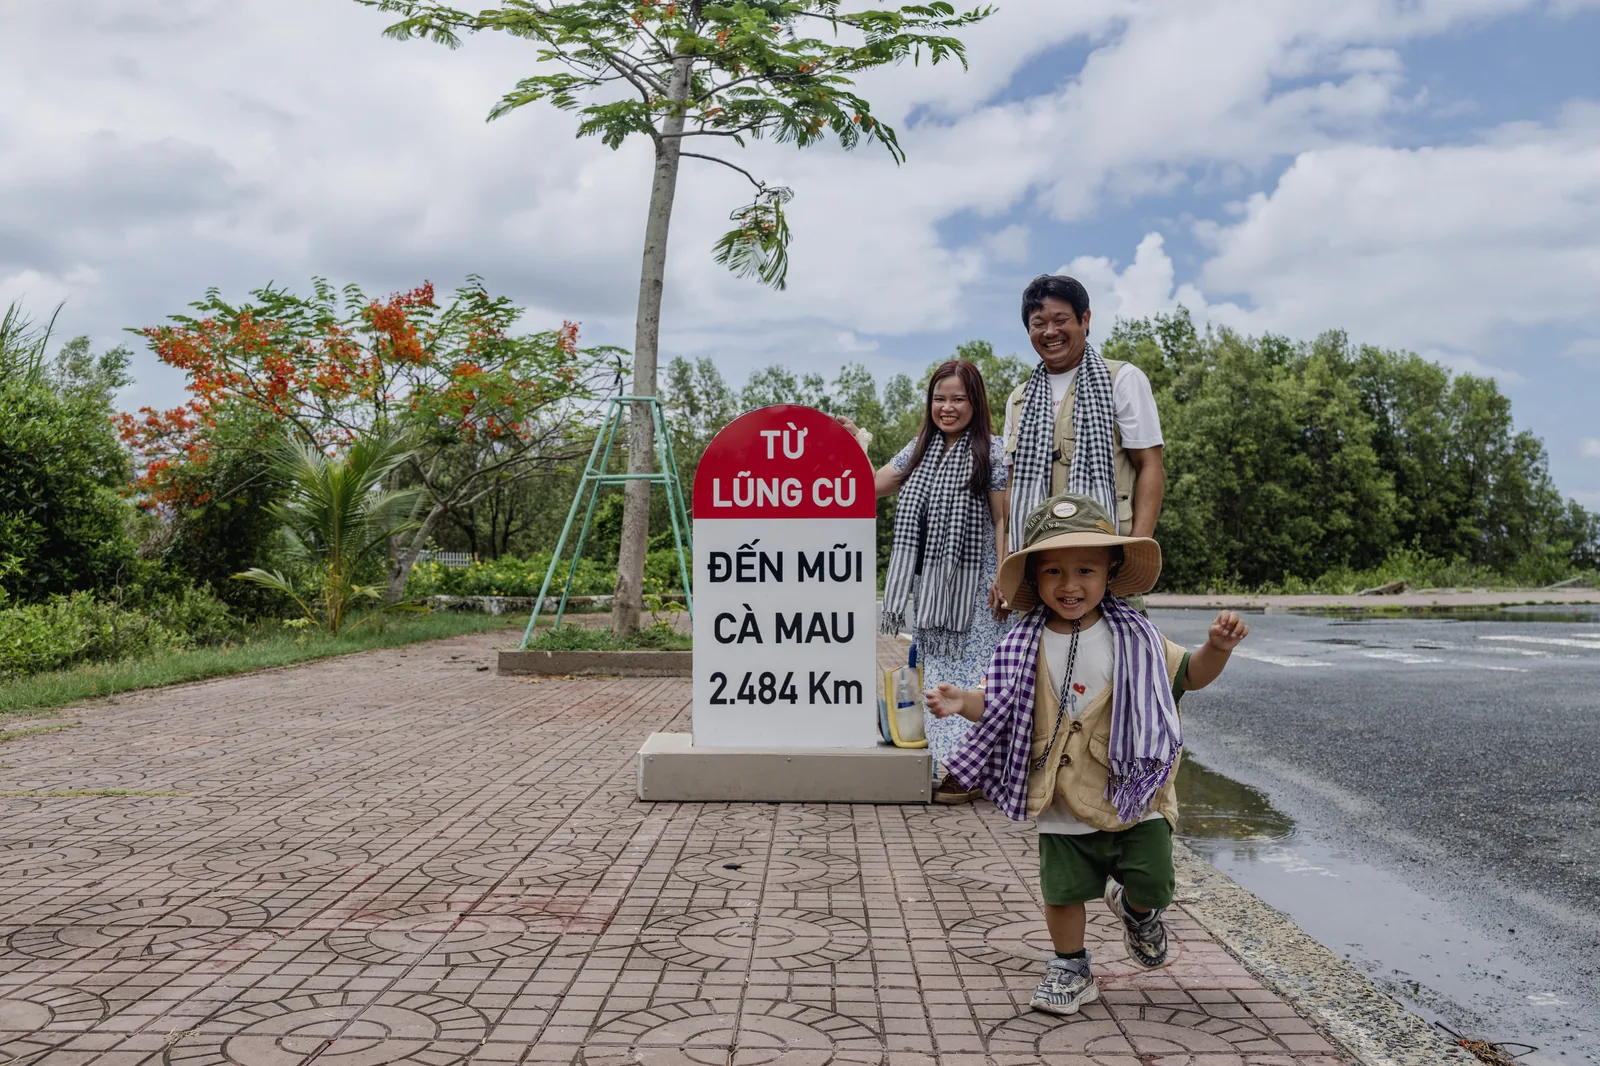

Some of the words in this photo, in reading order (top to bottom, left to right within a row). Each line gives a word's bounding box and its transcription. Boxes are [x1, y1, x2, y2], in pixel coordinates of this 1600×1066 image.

[760, 422, 808, 459] TỪ
[713, 471, 802, 507] LŨNG
[813, 470, 856, 507] CÚ
[1027, 514, 1042, 530] HAND
[1039, 521, 1060, 532] HAND
[708, 539, 783, 582] ĐẾN
[798, 543, 862, 582] MŨI
[715, 604, 763, 644] CÀ
[776, 612, 854, 644] MAU
[709, 672, 798, 705] 2.484
[809, 671, 863, 705] Km
